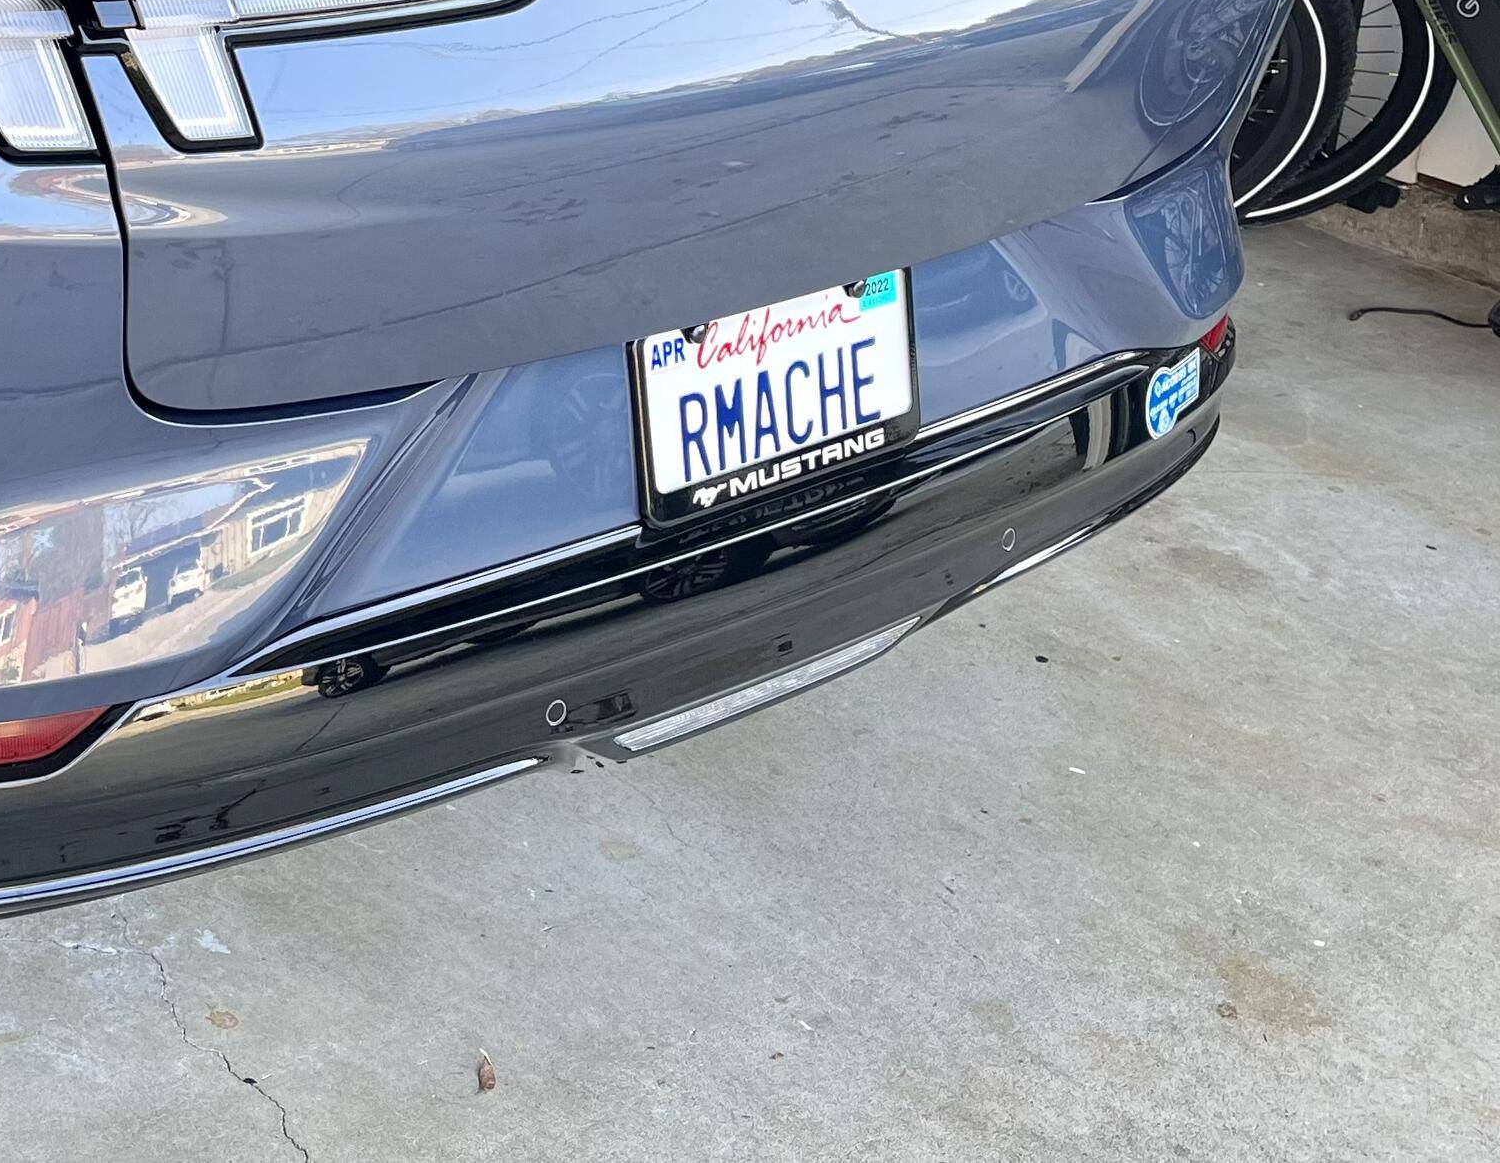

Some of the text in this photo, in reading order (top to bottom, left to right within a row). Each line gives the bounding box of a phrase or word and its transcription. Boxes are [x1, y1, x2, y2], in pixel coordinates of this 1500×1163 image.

[865, 278, 889, 296] 2022
[651, 338, 686, 370] APR
[697, 294, 861, 369] California
[679, 336, 882, 482] RMACHE
[729, 427, 886, 497] MUSTANG
